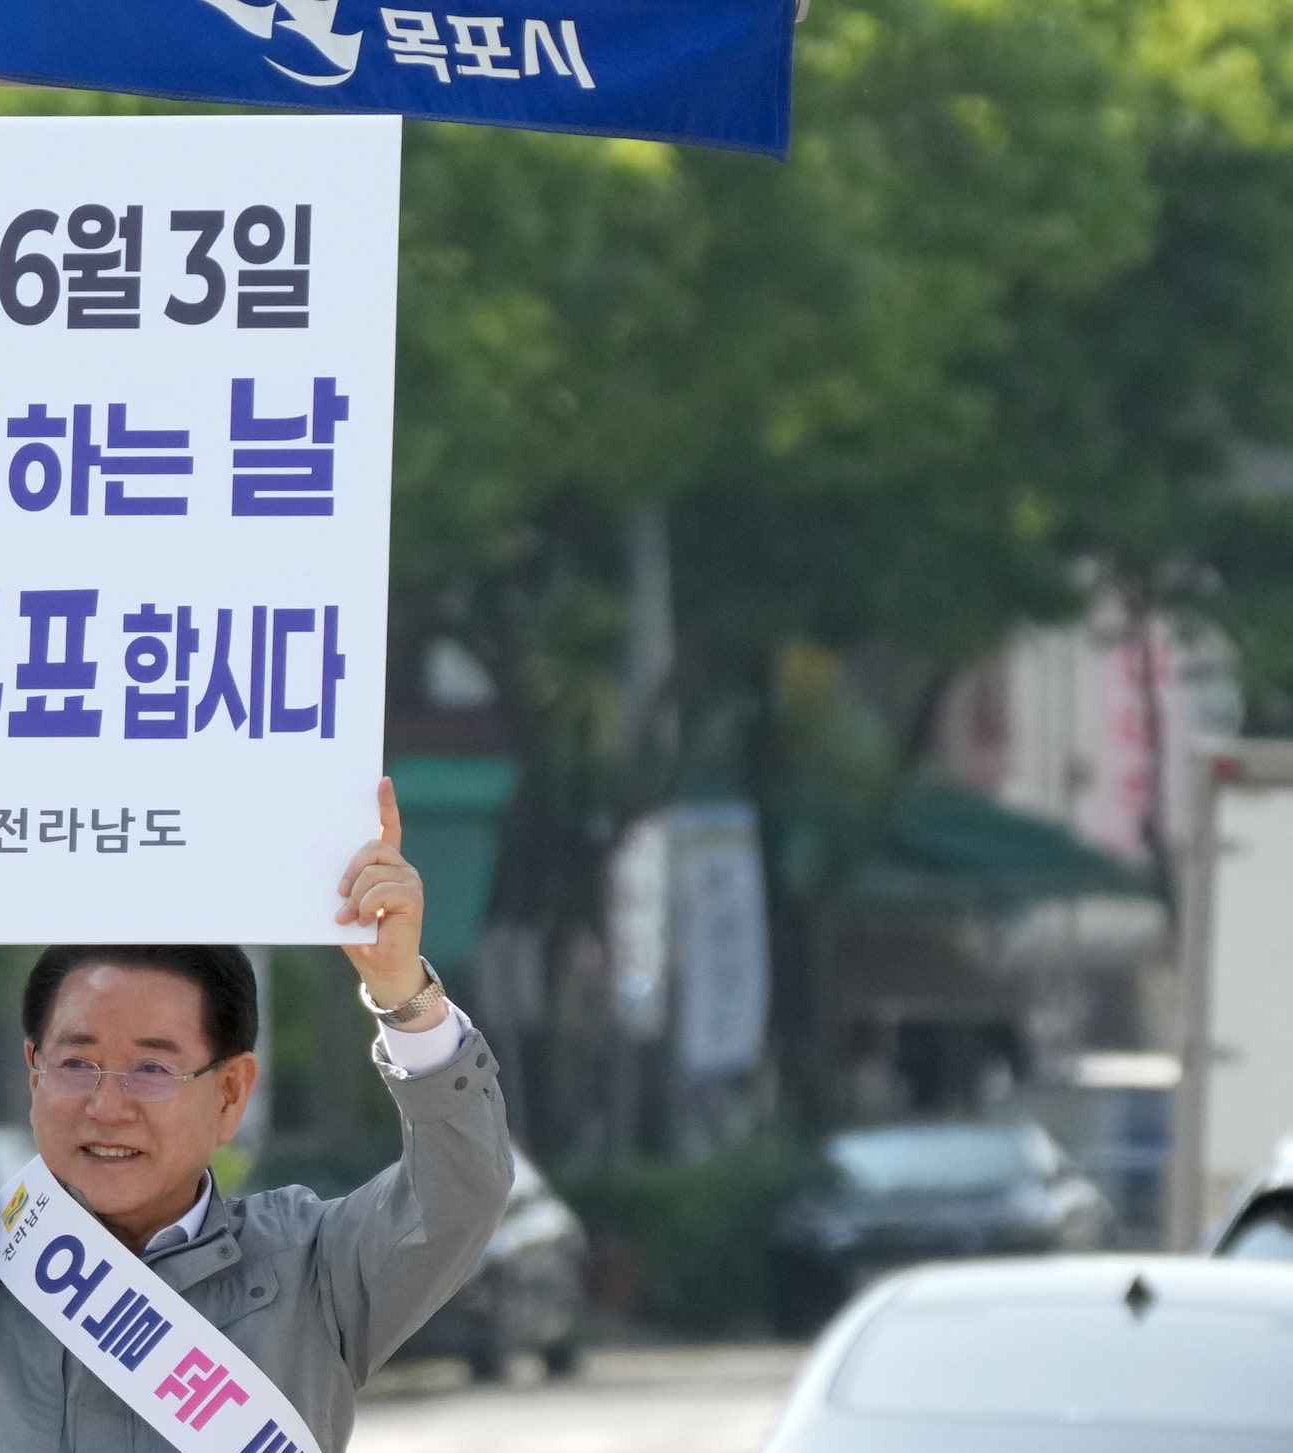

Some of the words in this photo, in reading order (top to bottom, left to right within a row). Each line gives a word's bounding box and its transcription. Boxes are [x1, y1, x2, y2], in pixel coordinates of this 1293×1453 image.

[381, 7, 595, 89] 목포시
[164, 203, 312, 330] 3일
[229, 376, 350, 518] 날
[3, 1192, 51, 1262] 전라남도
[34, 1233, 173, 1373] 오늘
[153, 1346, 251, 1433] 꼭
